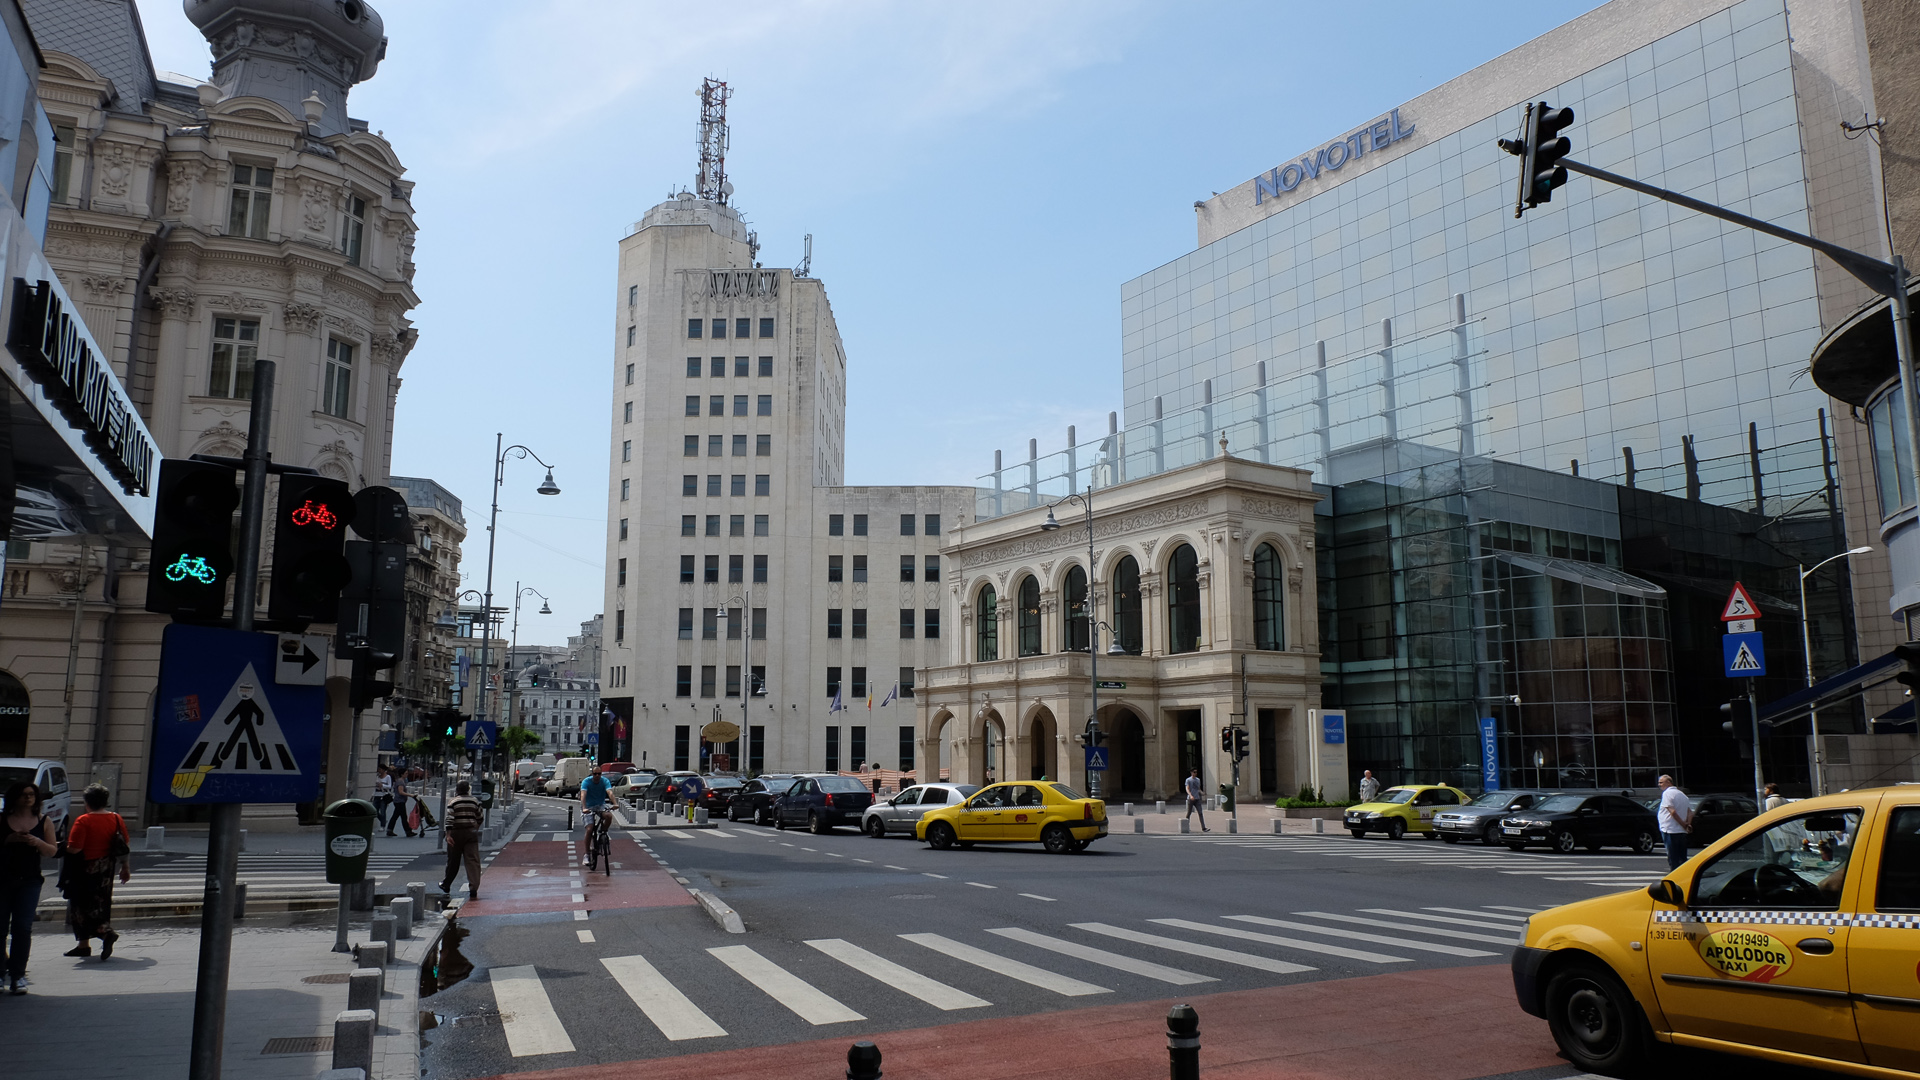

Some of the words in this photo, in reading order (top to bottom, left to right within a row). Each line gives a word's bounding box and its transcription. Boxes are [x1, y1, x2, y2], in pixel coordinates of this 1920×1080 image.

[1254, 108, 1416, 206] NOVOTEL
[40, 284, 109, 432] EMPORIO
[117, 412, 154, 497] ARMAN
[1484, 721, 1496, 782] NOVOTEL
[1649, 930, 1665, 941] 1,39
[1667, 931, 1697, 941] LEI/KM
[1727, 932, 1769, 947] 0219499
[1705, 946, 1787, 965] APOLODOR
[1717, 960, 1748, 973] TAXI
